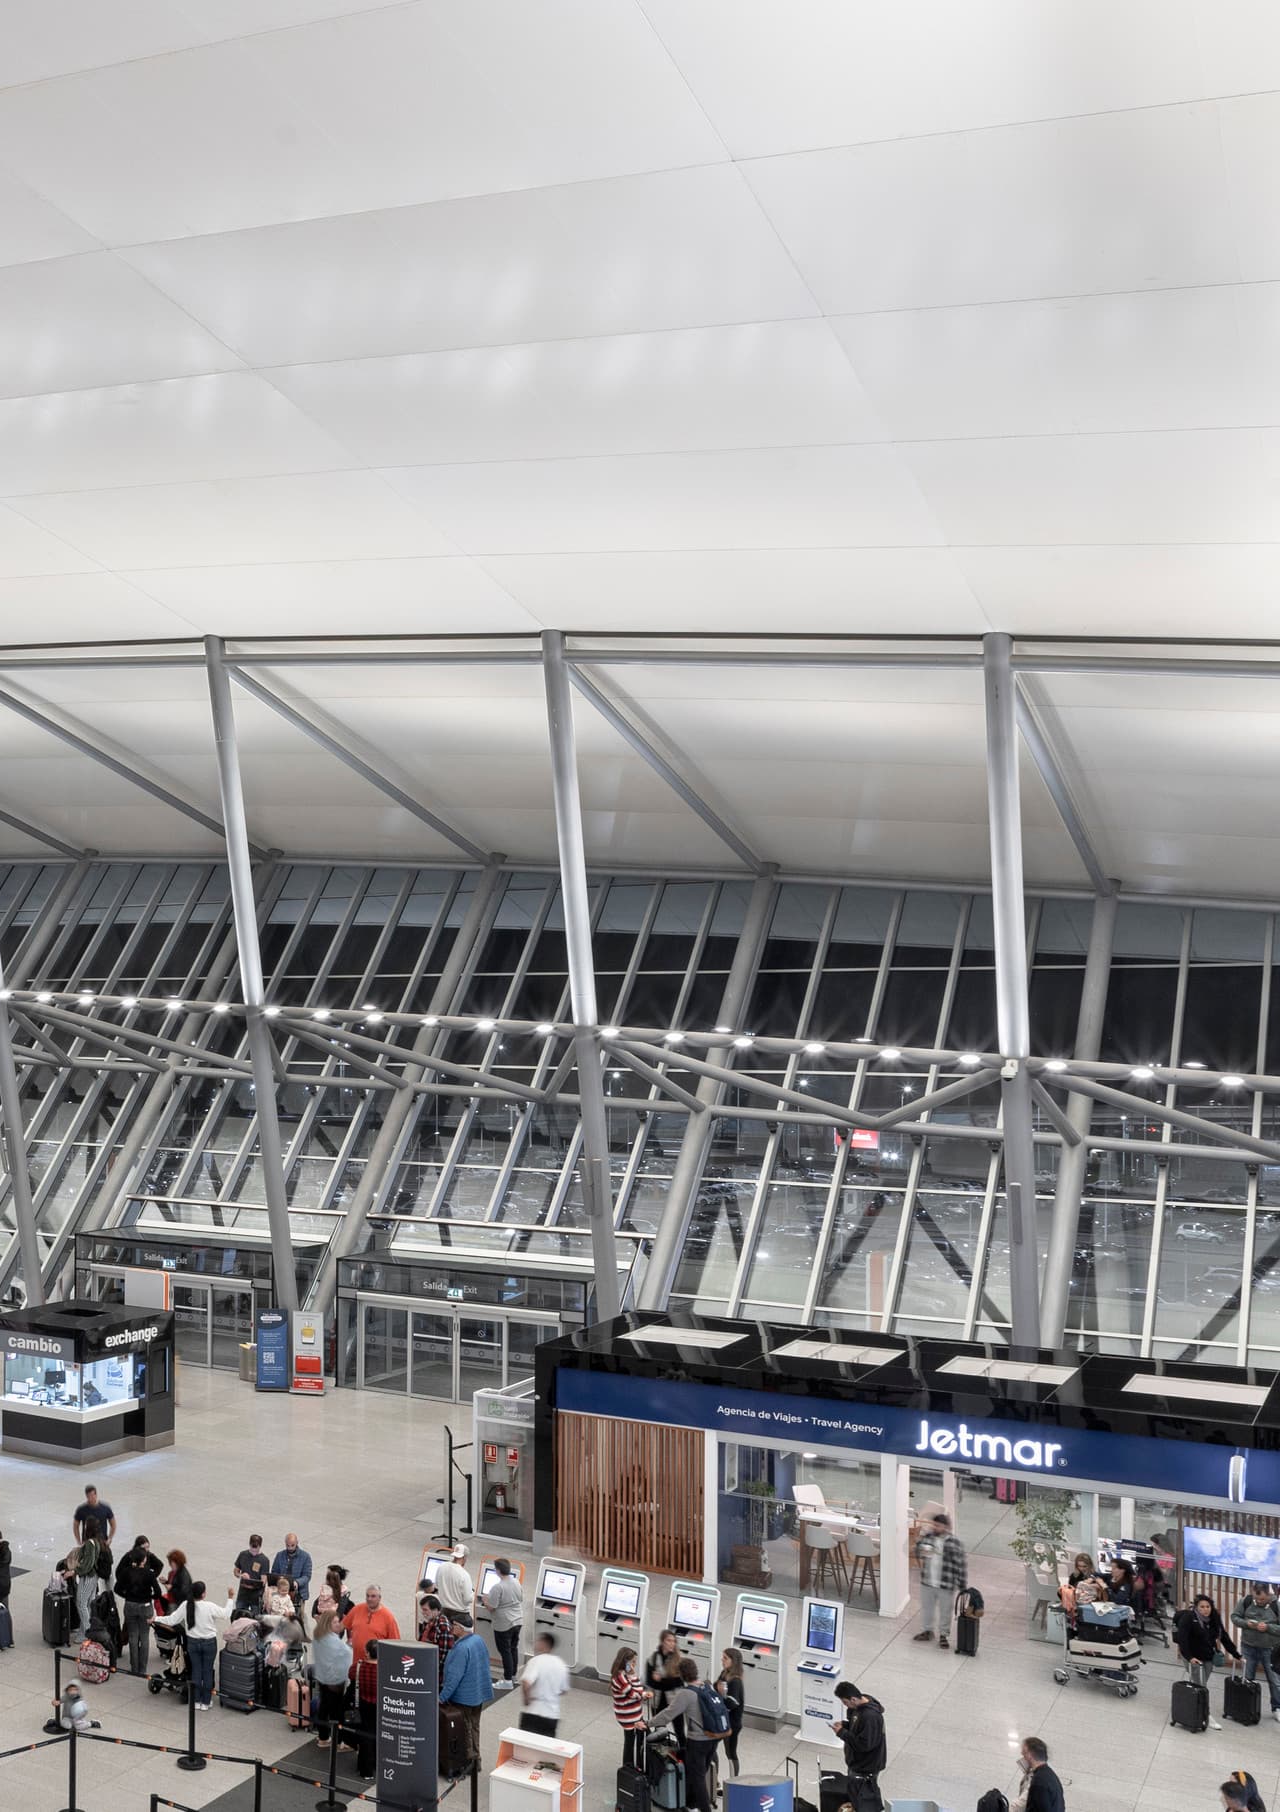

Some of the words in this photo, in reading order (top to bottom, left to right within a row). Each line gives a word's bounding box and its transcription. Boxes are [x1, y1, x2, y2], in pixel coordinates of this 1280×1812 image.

[144, 1253, 164, 1261] Salida
[176, 1256, 187, 1264] Exit
[423, 1281, 447, 1290] Salida
[464, 1285, 477, 1294] Exit
[105, 1325, 158, 1348] exchange
[8, 1335, 62, 1354] cambio
[717, 1405, 756, 1420] Agencia
[758, 1409, 771, 1419] de
[773, 1411, 802, 1424] Viajes
[811, 1416, 842, 1429] Travel
[844, 1420, 883, 1436] Agency
[915, 1419, 1062, 1468] Jetmar
[390, 1675, 424, 1685] LATAM
[383, 1696, 415, 1708] Check-in
[383, 1704, 416, 1716] Premium
